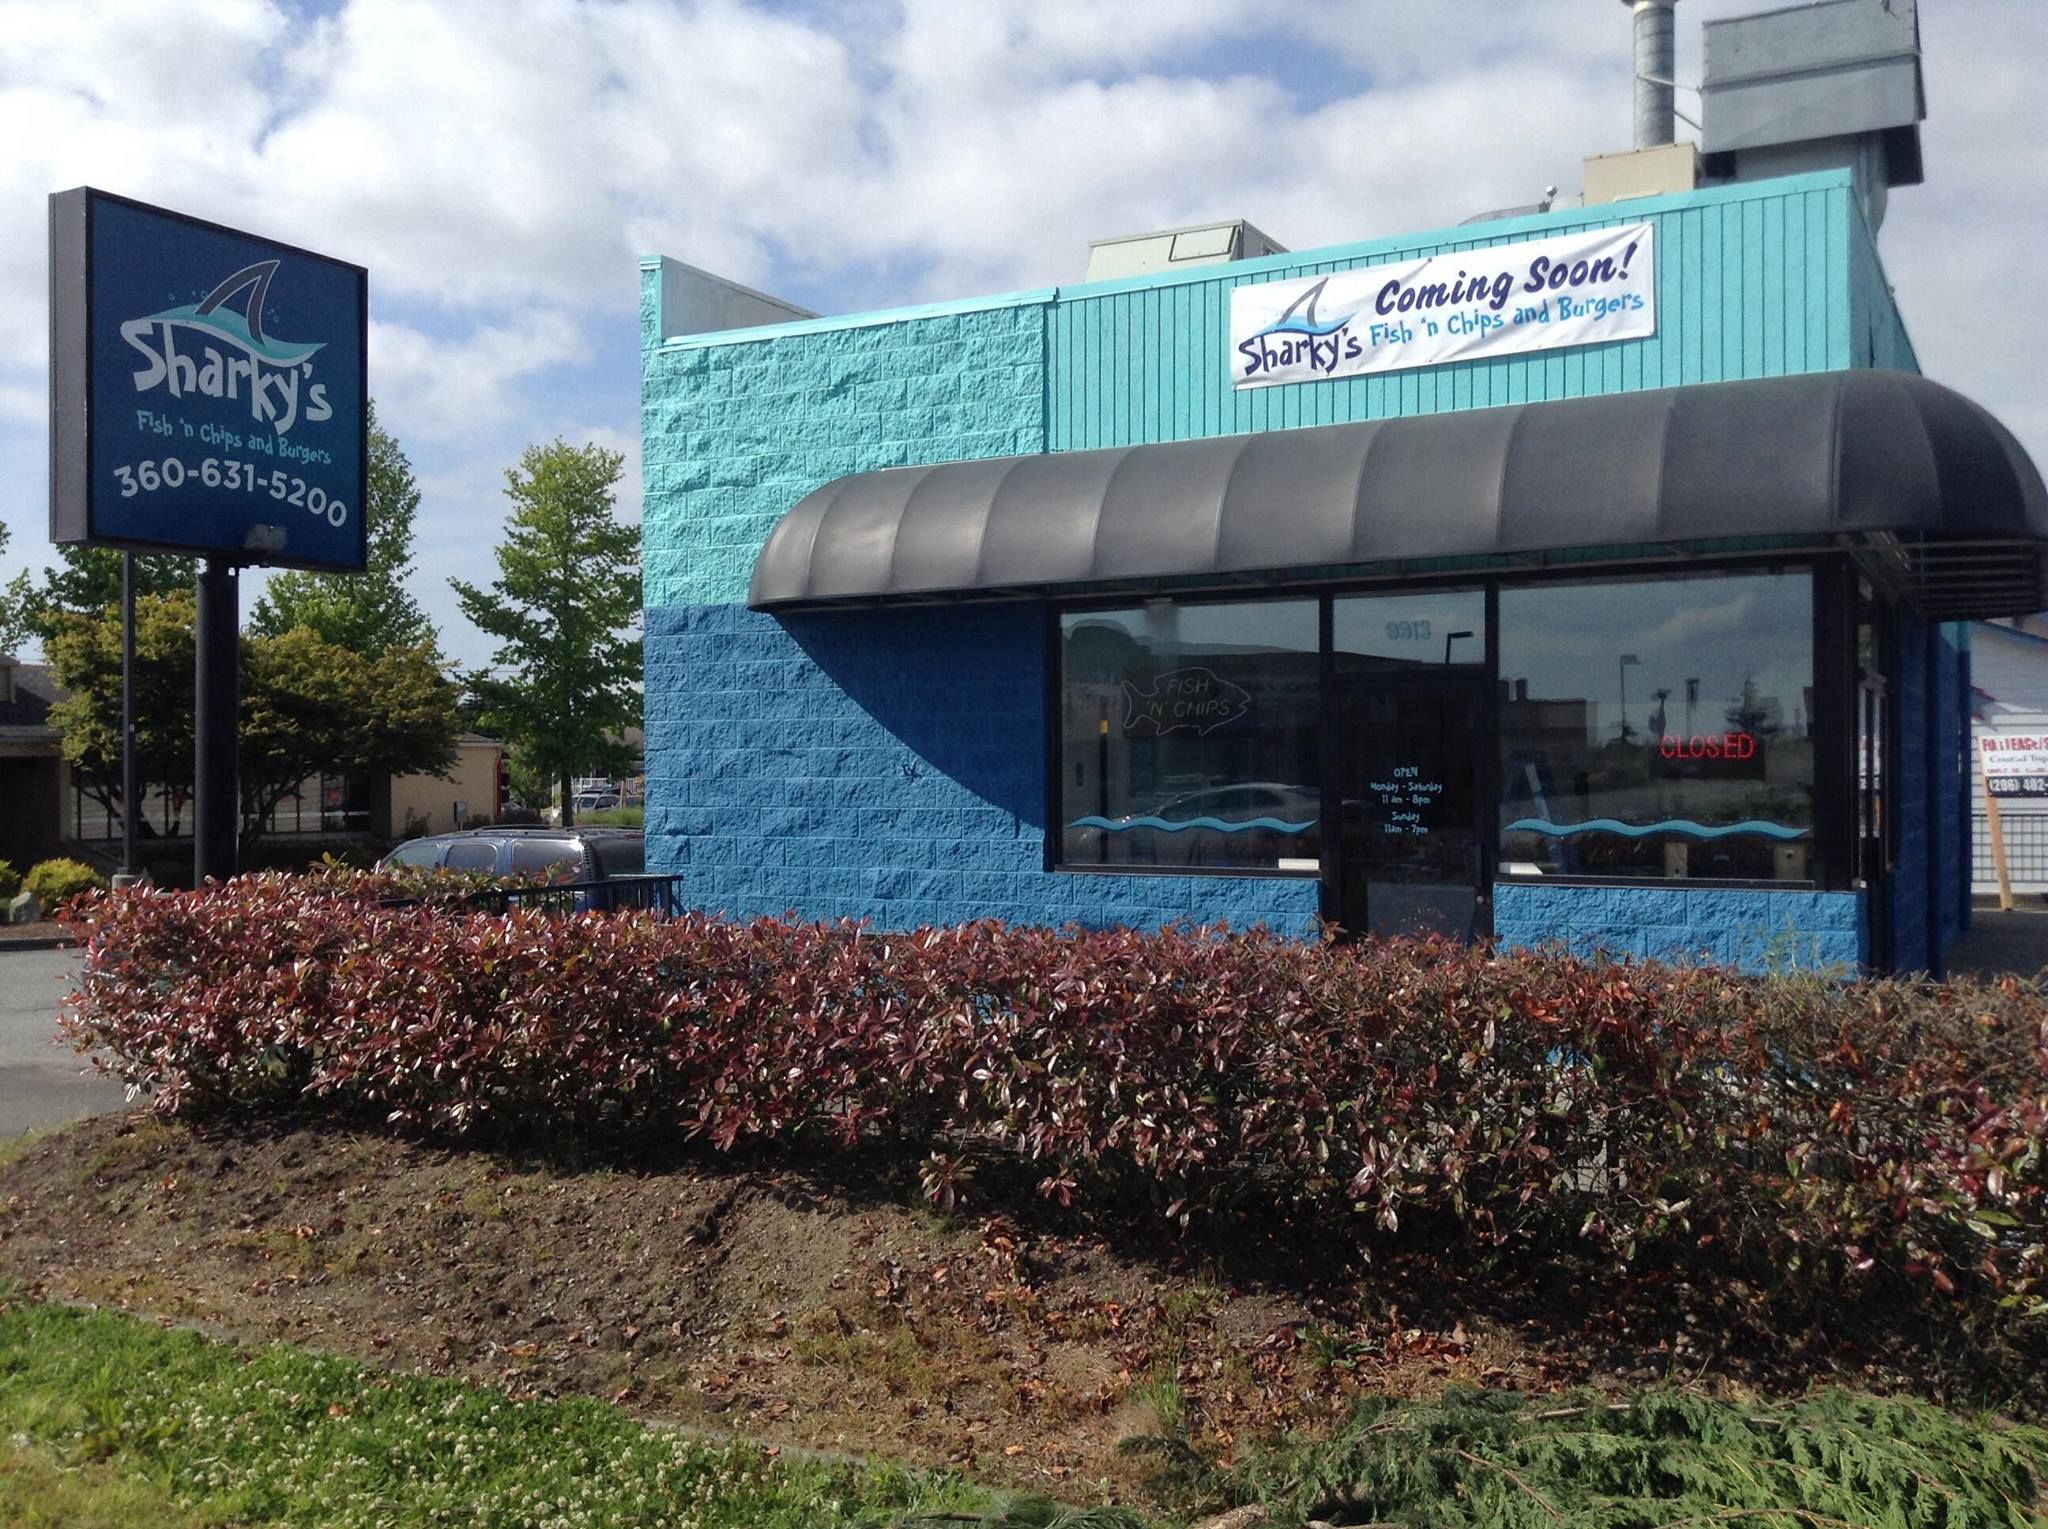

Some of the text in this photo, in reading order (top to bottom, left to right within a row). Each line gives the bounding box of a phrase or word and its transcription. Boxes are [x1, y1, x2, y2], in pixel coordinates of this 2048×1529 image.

[1375, 242, 1638, 315] Coming Soon!
[1369, 320, 1412, 346] Fish
[1448, 309, 1504, 338] Chips
[1513, 298, 1549, 325] and
[1557, 293, 1644, 321] Burgers
[1238, 327, 1363, 376] Sharky's
[120, 320, 333, 435] Sharky's
[136, 410, 173, 437] Fish
[200, 424, 242, 452] Chips
[248, 435, 273, 455] and
[278, 437, 332, 464] Burgers
[113, 456, 347, 527] 360-631-5200
[1166, 678, 1210, 695] FISH
[1174, 699, 1231, 718] CHIPS
[1660, 733, 1755, 759] CLOSED
[1393, 766, 1418, 777] OPEN
[1370, 781, 1399, 794] Monday
[1408, 781, 1442, 794] Saturday
[1412, 794, 1430, 806] 8pm
[1391, 810, 1420, 823] Sunday
[1411, 824, 1428, 836] 7pm
